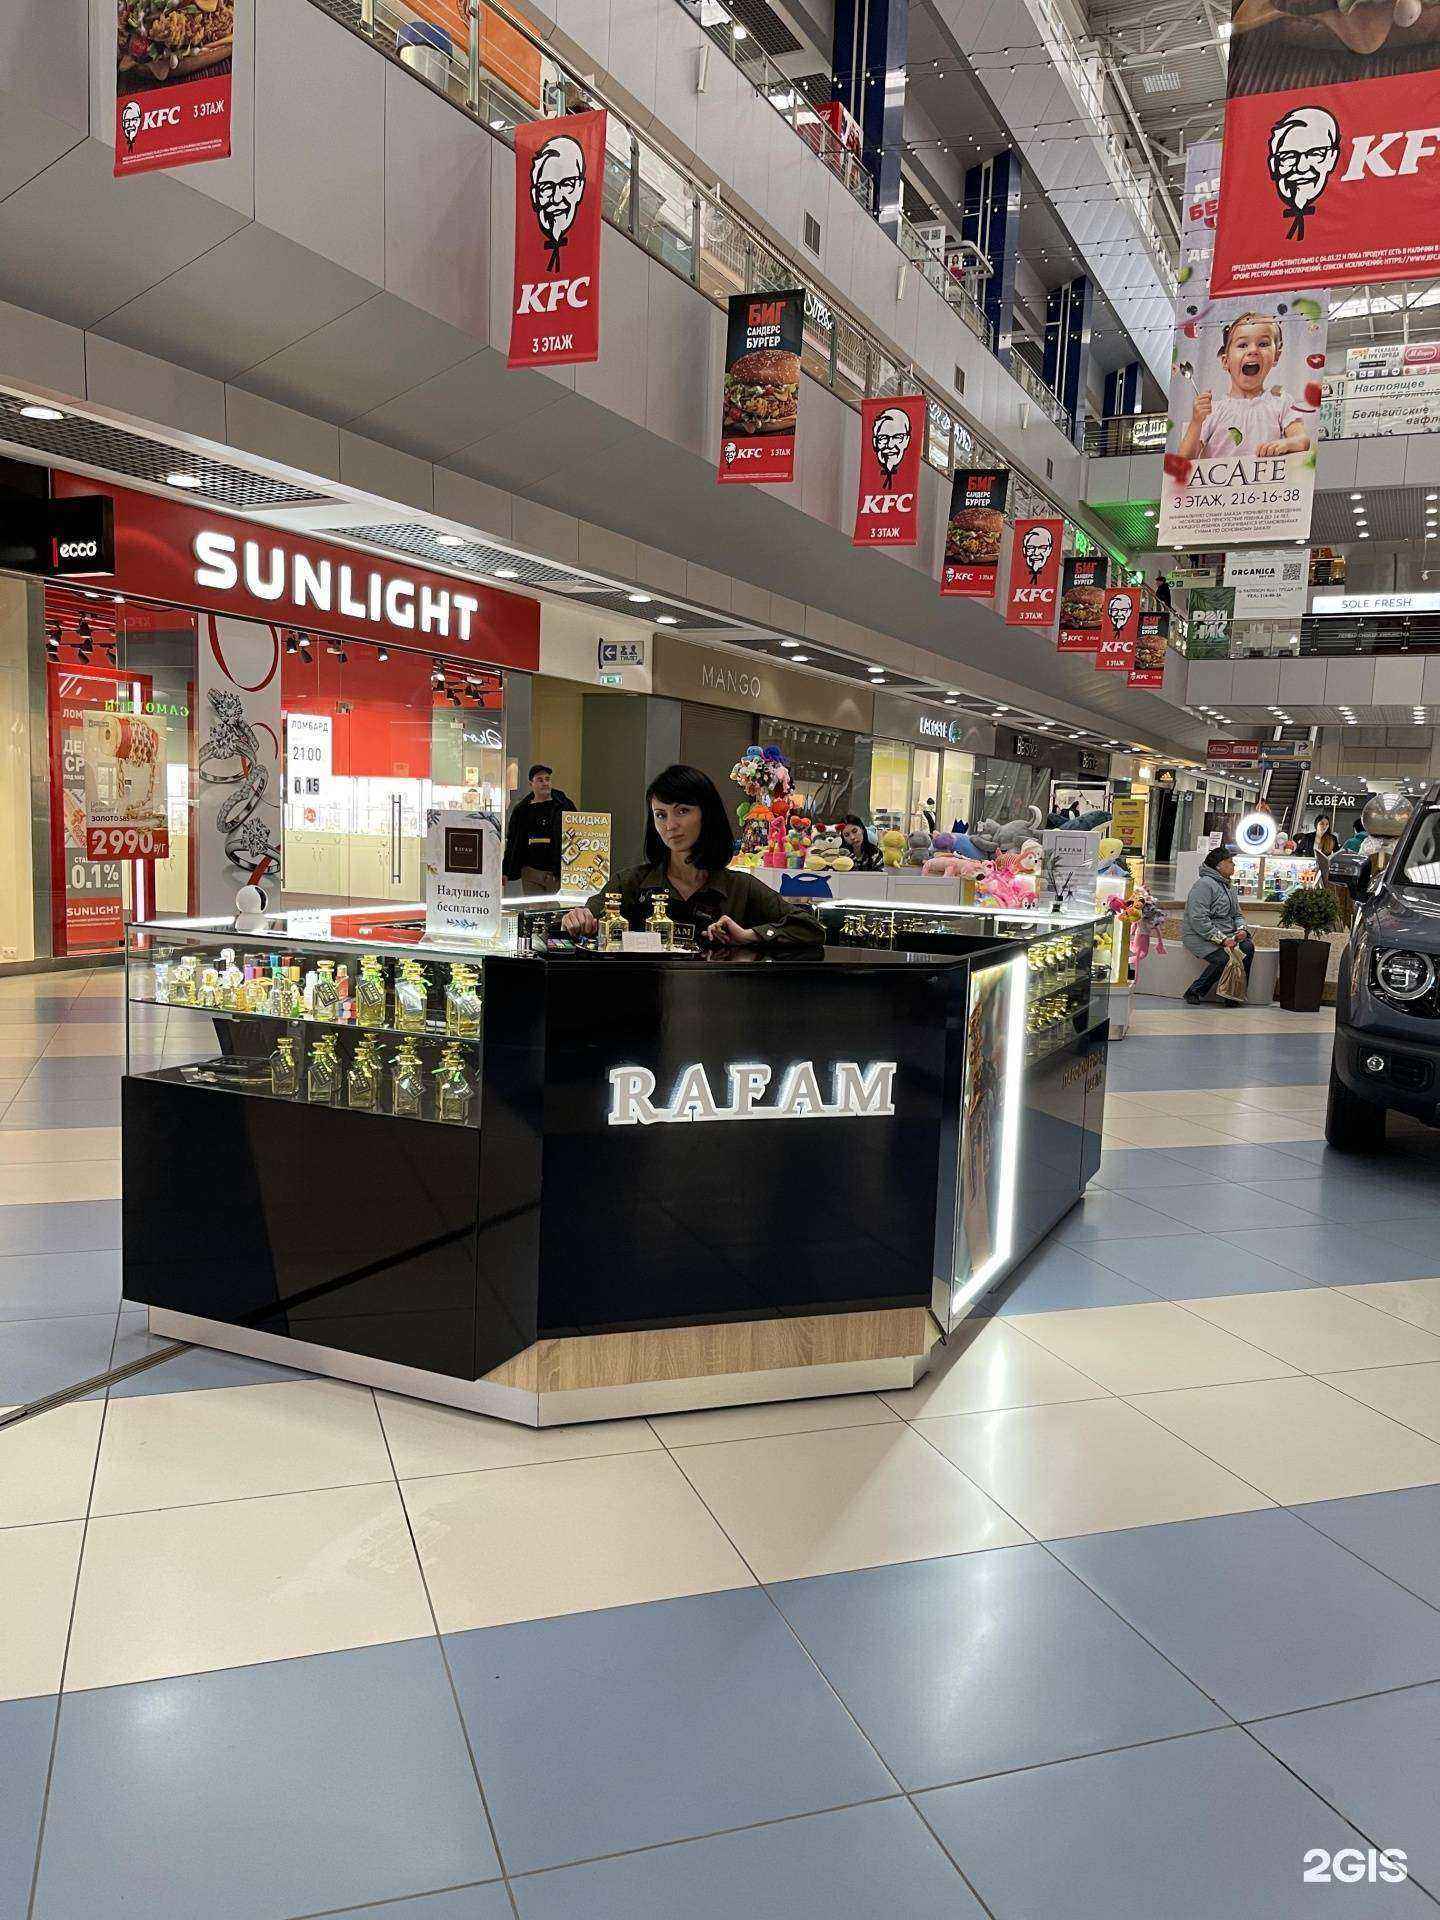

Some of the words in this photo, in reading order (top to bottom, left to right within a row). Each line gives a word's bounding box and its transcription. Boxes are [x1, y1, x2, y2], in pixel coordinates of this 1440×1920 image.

[193, 105, 199, 118] 3
[200, 99, 225, 117] ЭТАЖ
[142, 105, 181, 131] KFC
[1341, 127, 1440, 182] KF
[1362, 249, 1388, 258] ПРОДУКТ
[1388, 248, 1401, 256] ЕСТЬ
[516, 276, 591, 315] KFC
[748, 301, 786, 326] БИГ
[747, 325, 781, 336] САНДЕРС
[532, 337, 539, 353] 3
[541, 333, 573, 353] ЭТАЖ
[746, 336, 781, 349] БУРГЕР
[1354, 380, 1425, 393] Настоящее
[1352, 406, 1429, 420] Бельгийские
[736, 448, 763, 459] KFC
[1187, 459, 1286, 488] ACAFE
[968, 476, 996, 491] БИГ
[860, 493, 914, 514] KFC
[965, 498, 991, 506] БУРГЕР
[1174, 497, 1182, 509] 3
[1230, 489, 1300, 506] 216-16-38
[870, 528, 876, 538] 3
[877, 527, 901, 538] ЭТАЖ
[60, 541, 97, 558] ecco
[954, 572, 974, 581] KFC
[1231, 568, 1276, 576] ORGANICA
[192, 530, 479, 642] SUNLIGHT
[1012, 588, 1055, 603] KFC
[1341, 599, 1372, 609] SOLE
[1374, 598, 1412, 608] FRESH
[1100, 641, 1133, 653] KFC
[702, 664, 762, 698] MANGO
[62, 708, 83, 719] ЛОМ
[291, 720, 328, 732] ЛОМБАРД
[65, 756, 85, 772] СР
[1306, 796, 1355, 807] L&BEAR
[565, 814, 608, 825] СКИДКА
[92, 829, 154, 855] 2990
[579, 838, 609, 852] 20%
[437, 885, 490, 899] Надушись
[66, 906, 120, 916] SUNLIGHT
[437, 902, 489, 915] бесплатно
[609, 1062, 897, 1125] RAFAM
